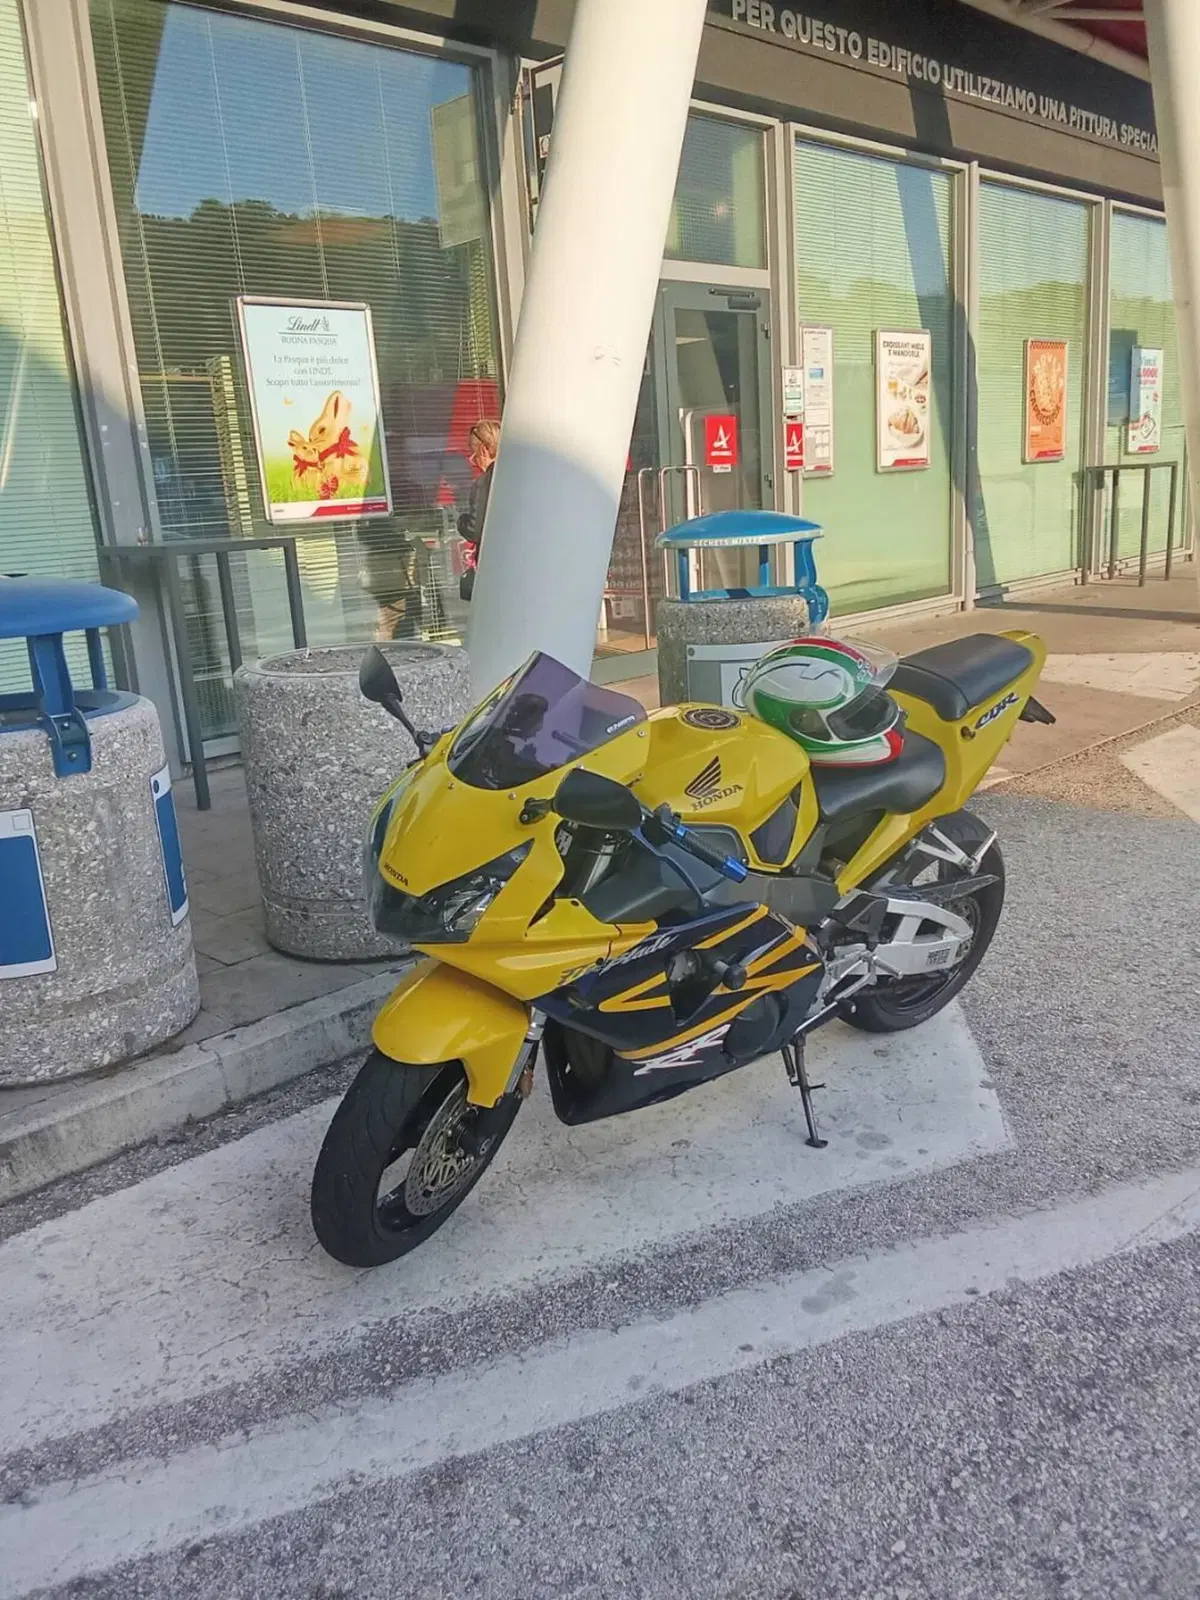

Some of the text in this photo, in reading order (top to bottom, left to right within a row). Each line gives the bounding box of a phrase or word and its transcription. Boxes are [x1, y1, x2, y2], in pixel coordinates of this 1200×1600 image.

[732, 0, 775, 32] PER
[780, 9, 863, 59] QUESTO
[867, 37, 941, 84] EDIFICIO
[944, 64, 1037, 114] UTILIZZIAMO
[1039, 95, 1068, 124] UNA
[1069, 105, 1118, 141] PITTURA
[286, 315, 321, 331] Lindt
[690, 782, 744, 811] HONDA
[384, 861, 409, 887] HONDA
